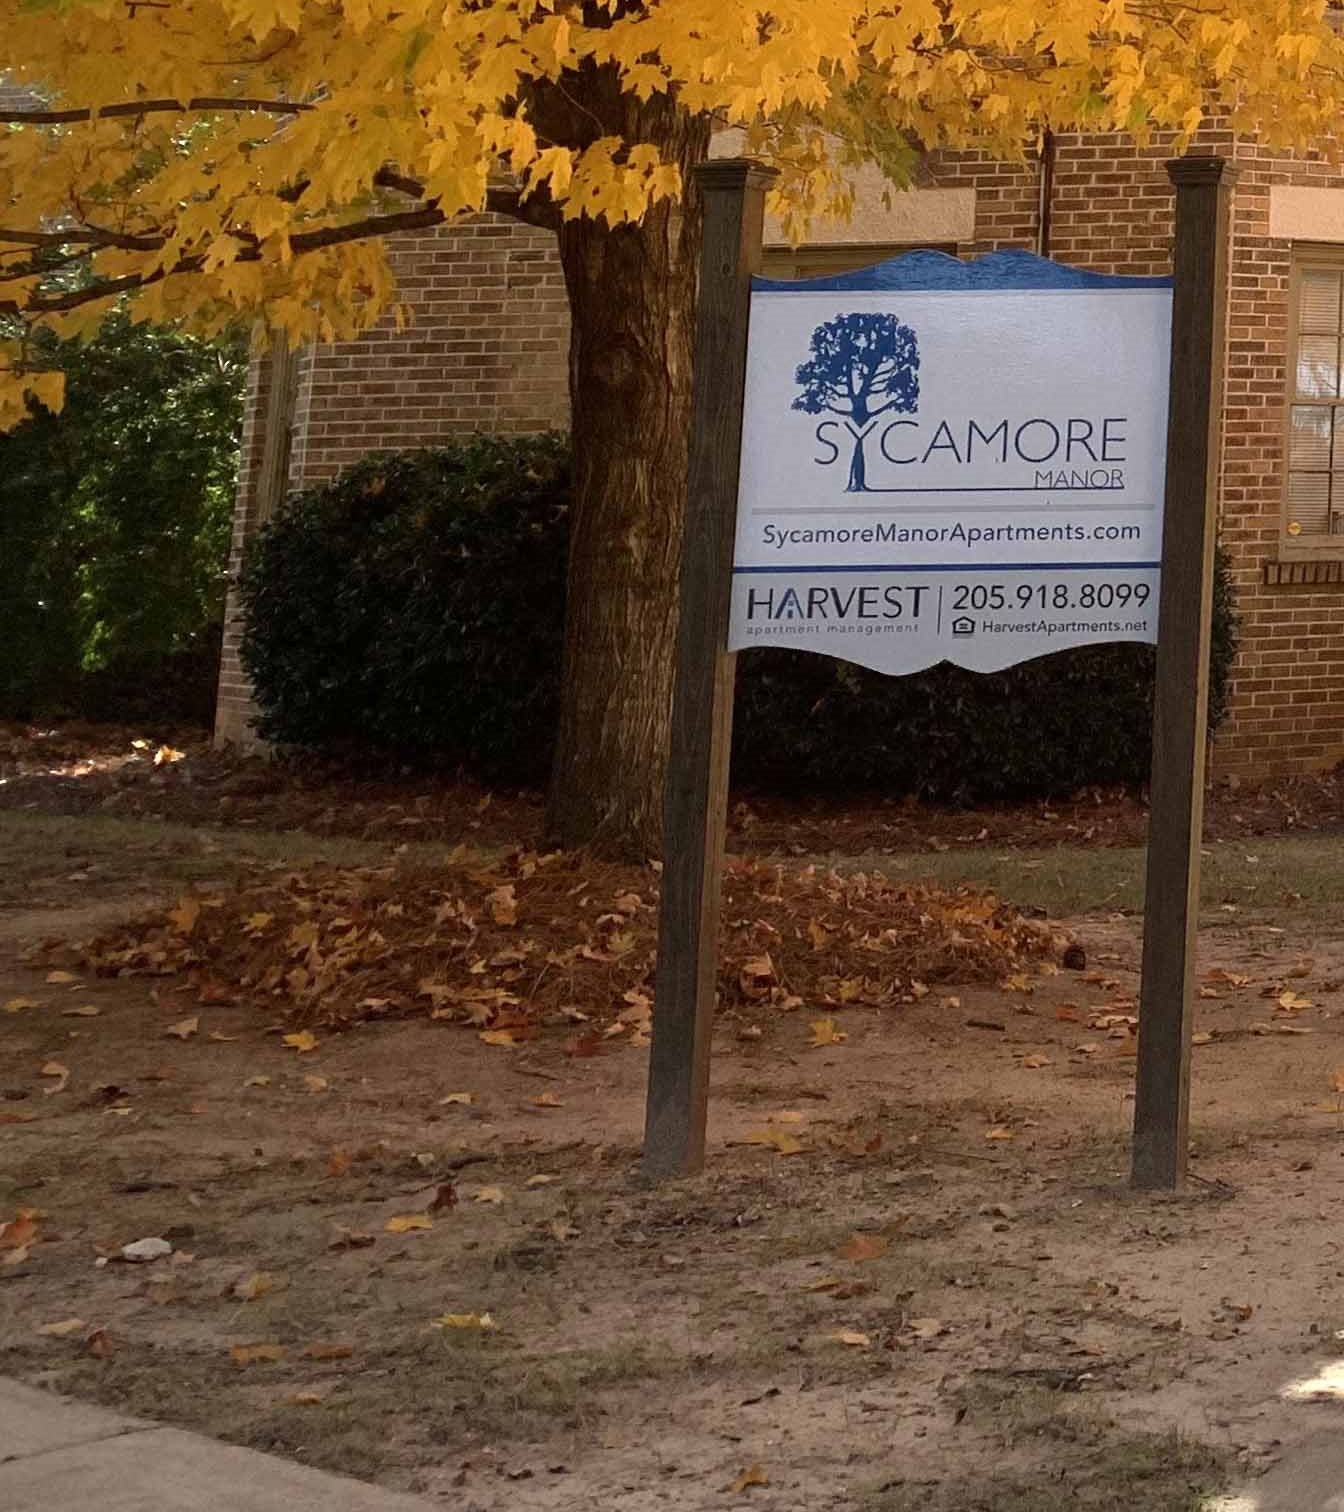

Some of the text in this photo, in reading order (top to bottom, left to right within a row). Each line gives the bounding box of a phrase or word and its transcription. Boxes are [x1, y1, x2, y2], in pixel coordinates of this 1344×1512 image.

[813, 417, 1128, 465] SYCAMORE
[1034, 468, 1125, 489] MANOR
[761, 522, 1142, 549] SycamoreManorApartments.com
[746, 585, 931, 620] HARVEST
[951, 583, 1151, 610] 205.918.8099
[746, 623, 920, 637] apartment management
[982, 619, 1149, 637] HarvestApartments.net
